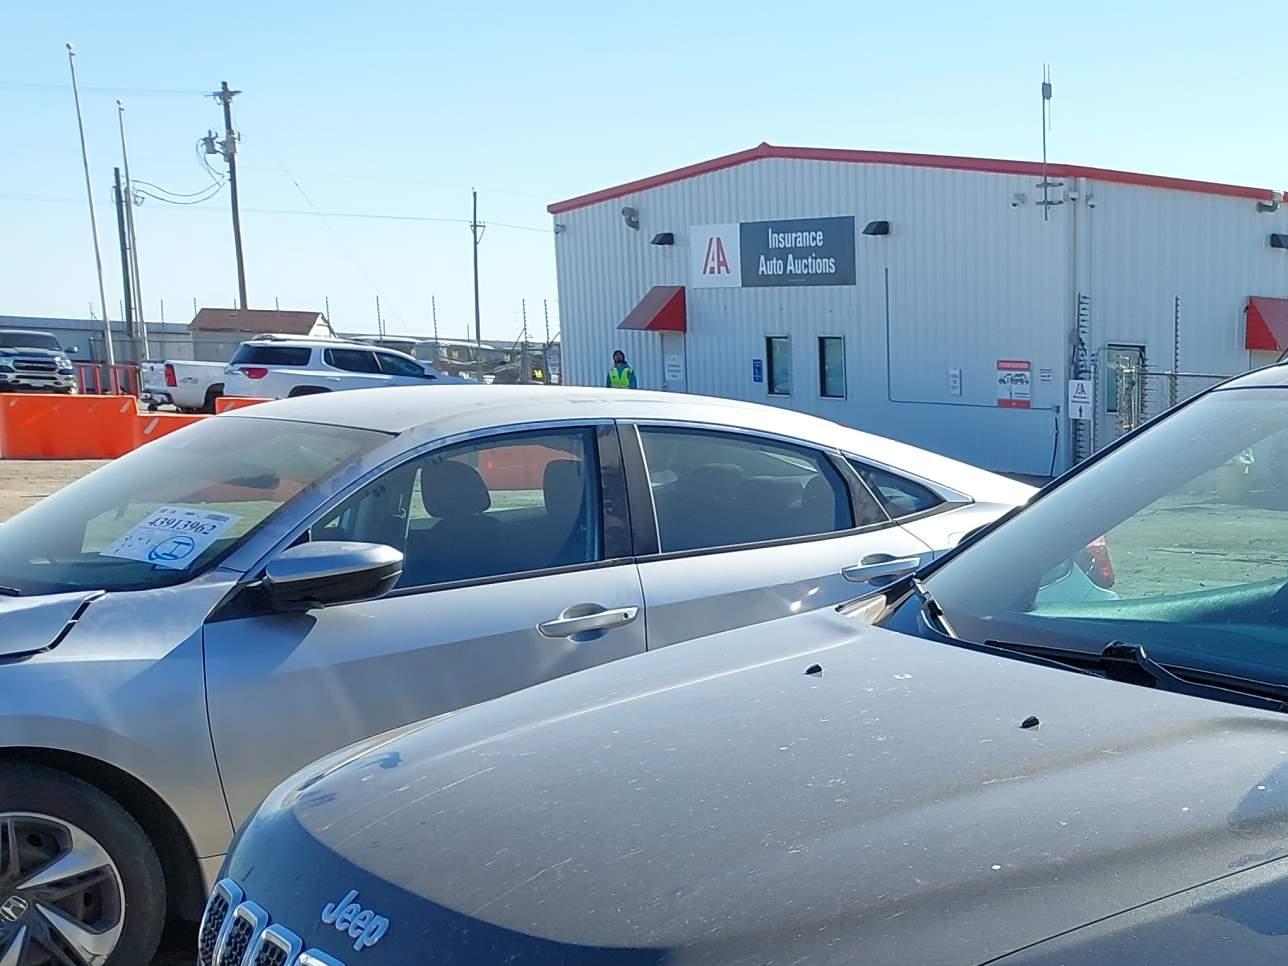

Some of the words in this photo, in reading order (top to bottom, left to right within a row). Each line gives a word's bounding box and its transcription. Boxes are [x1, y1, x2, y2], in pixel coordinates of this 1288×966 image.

[768, 228, 824, 249] Insurance
[758, 254, 784, 275] Auto
[786, 252, 836, 275] Auctions
[149, 516, 217, 535] 43913962
[321, 889, 390, 951] Jeep
